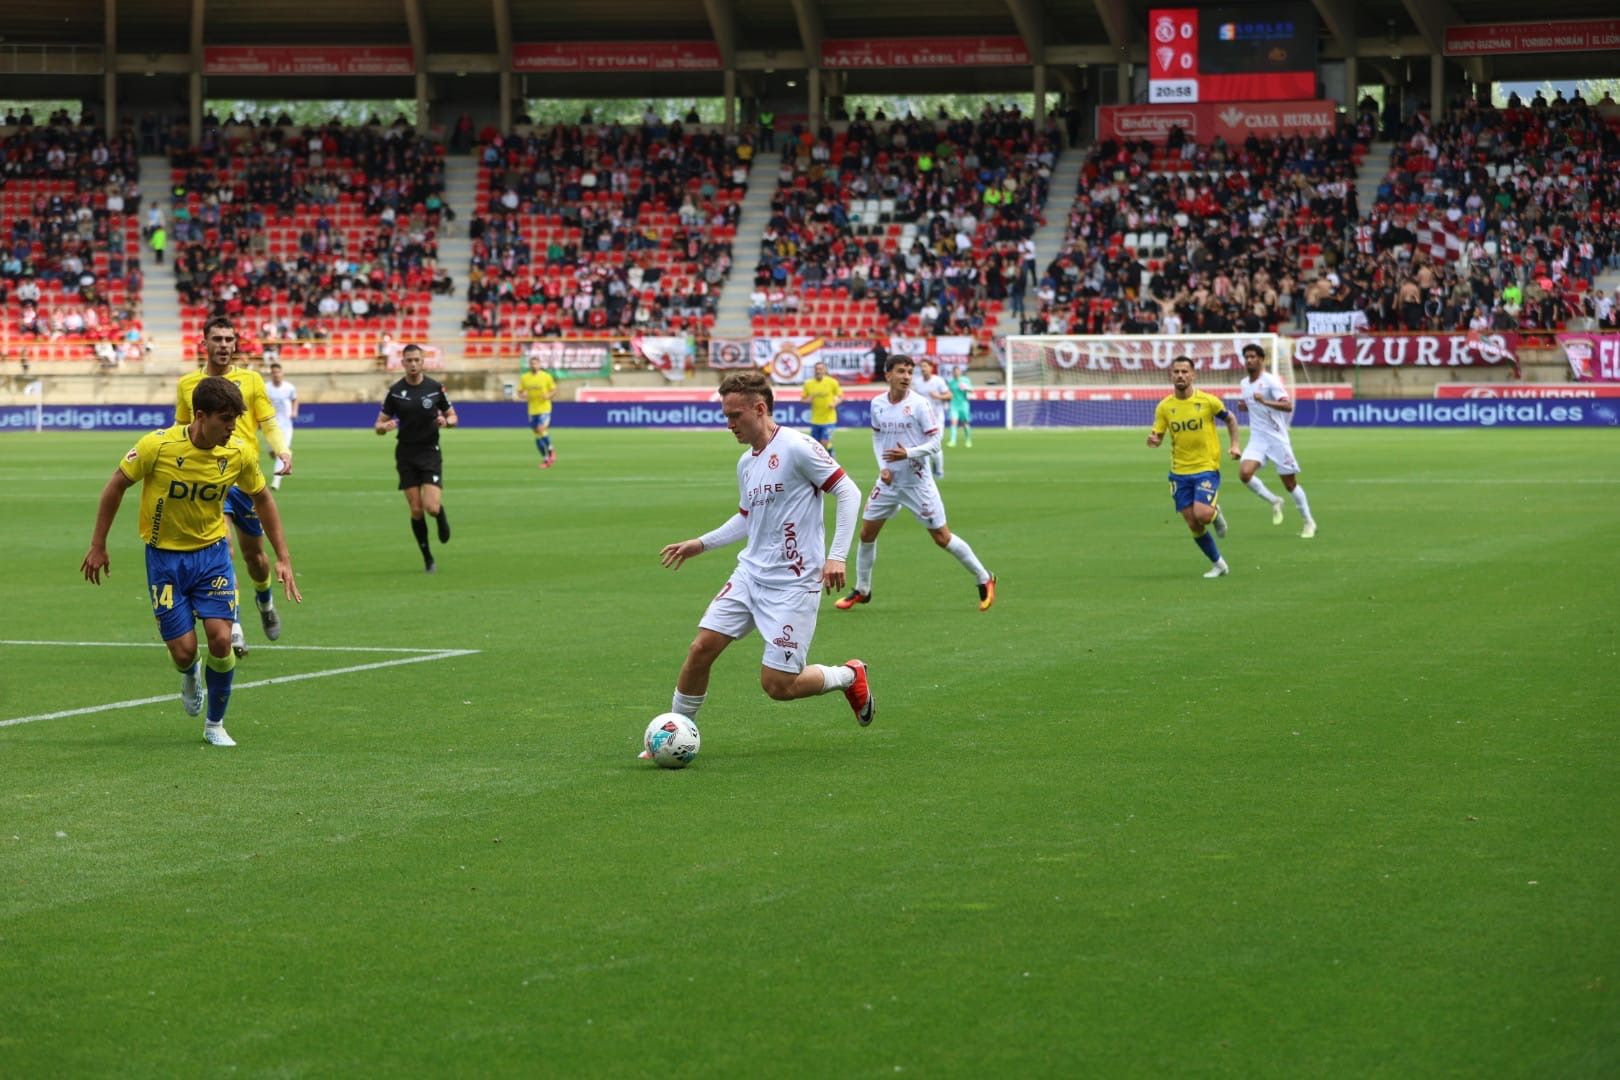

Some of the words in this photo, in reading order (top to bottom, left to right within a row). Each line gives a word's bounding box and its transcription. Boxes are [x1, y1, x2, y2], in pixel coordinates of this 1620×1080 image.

[1180, 22, 1193, 39] 0
[1180, 53, 1193, 69] 0
[1156, 87, 1192, 98] 20:58
[1245, 116, 1280, 128] CAJA
[1283, 112, 1331, 127] RURAL
[1293, 334, 1506, 366] CAZURRO
[1332, 403, 1583, 425] mihuelladigital.es
[1170, 419, 1203, 433] DIGI
[168, 480, 228, 502] DIGI
[783, 522, 799, 561] MGS
[152, 584, 174, 610] 34
